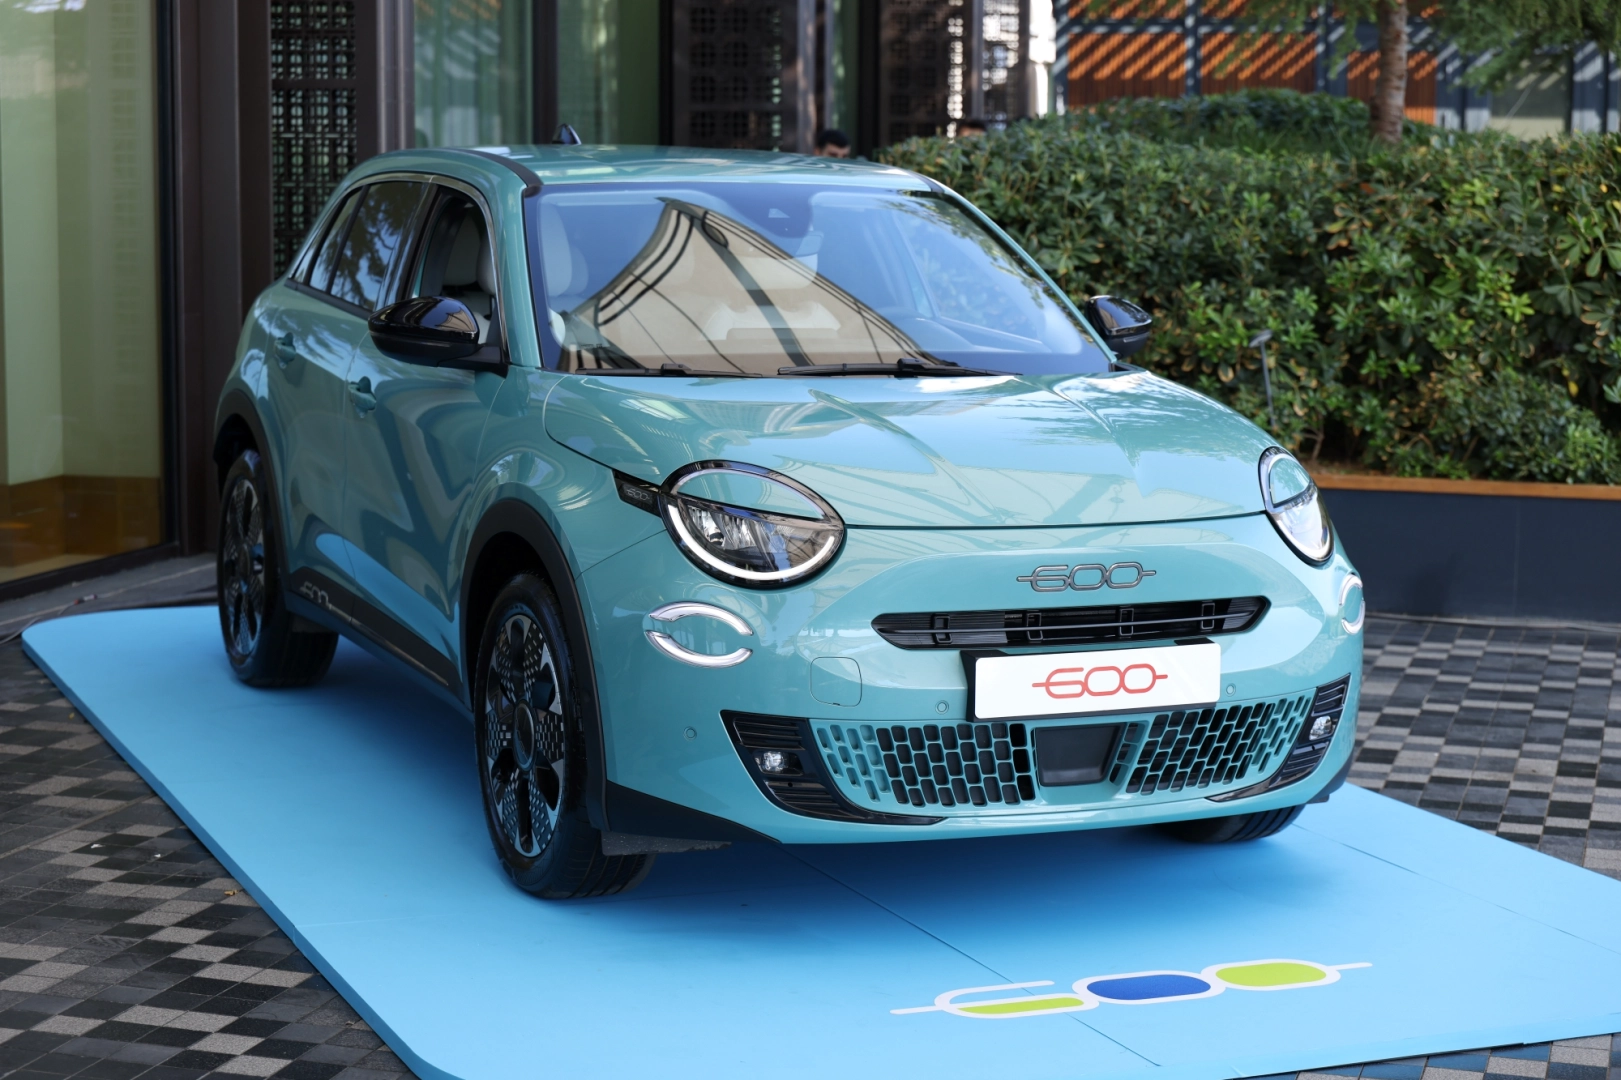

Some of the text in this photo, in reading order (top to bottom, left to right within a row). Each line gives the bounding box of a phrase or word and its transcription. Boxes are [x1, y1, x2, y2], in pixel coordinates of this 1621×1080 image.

[626, 488, 650, 501] 600
[1016, 561, 1157, 592] 600
[1032, 663, 1169, 699] 600
[890, 958, 1373, 1019] 600
